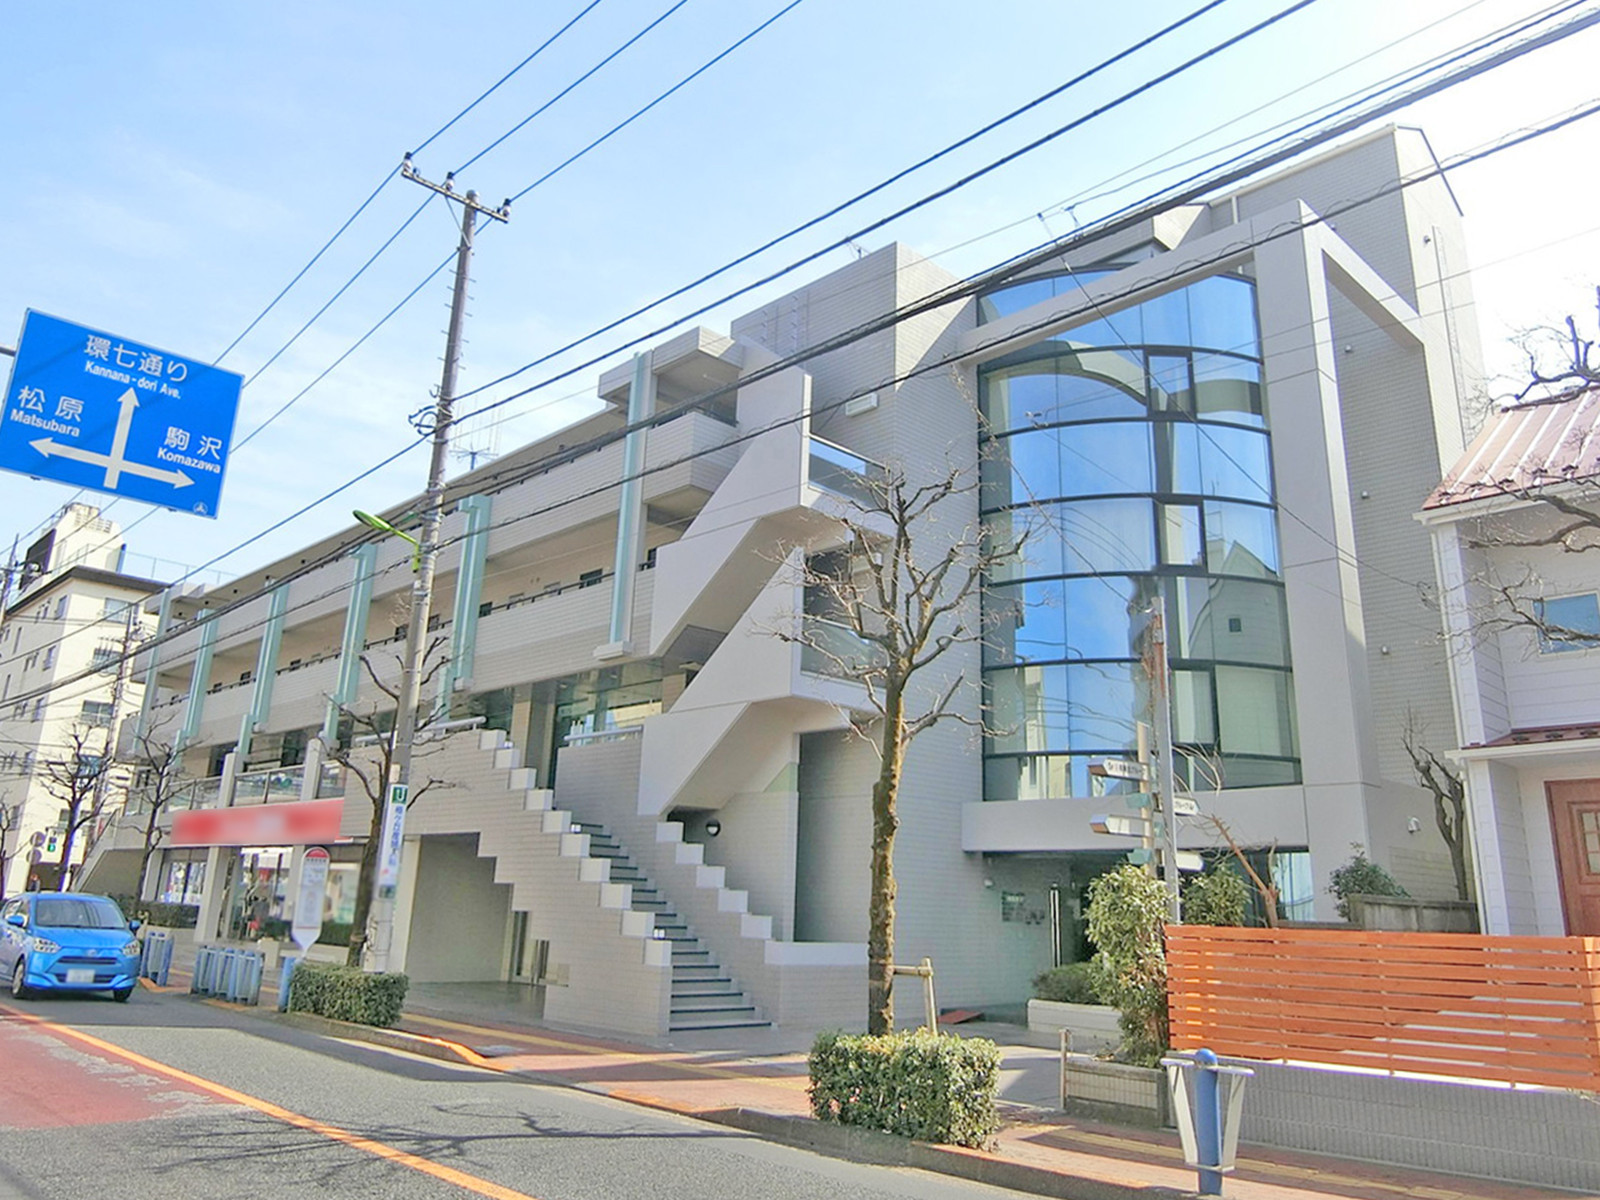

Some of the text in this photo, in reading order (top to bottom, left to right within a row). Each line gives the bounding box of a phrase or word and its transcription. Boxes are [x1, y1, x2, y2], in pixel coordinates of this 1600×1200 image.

[84, 334, 188, 382] 環七通り
[18, 385, 85, 422] 松原
[159, 382, 182, 399] Ave.
[10, 408, 80, 437] Matsubara
[164, 426, 222, 460] 駒沢
[157, 447, 221, 474] Komazawa
